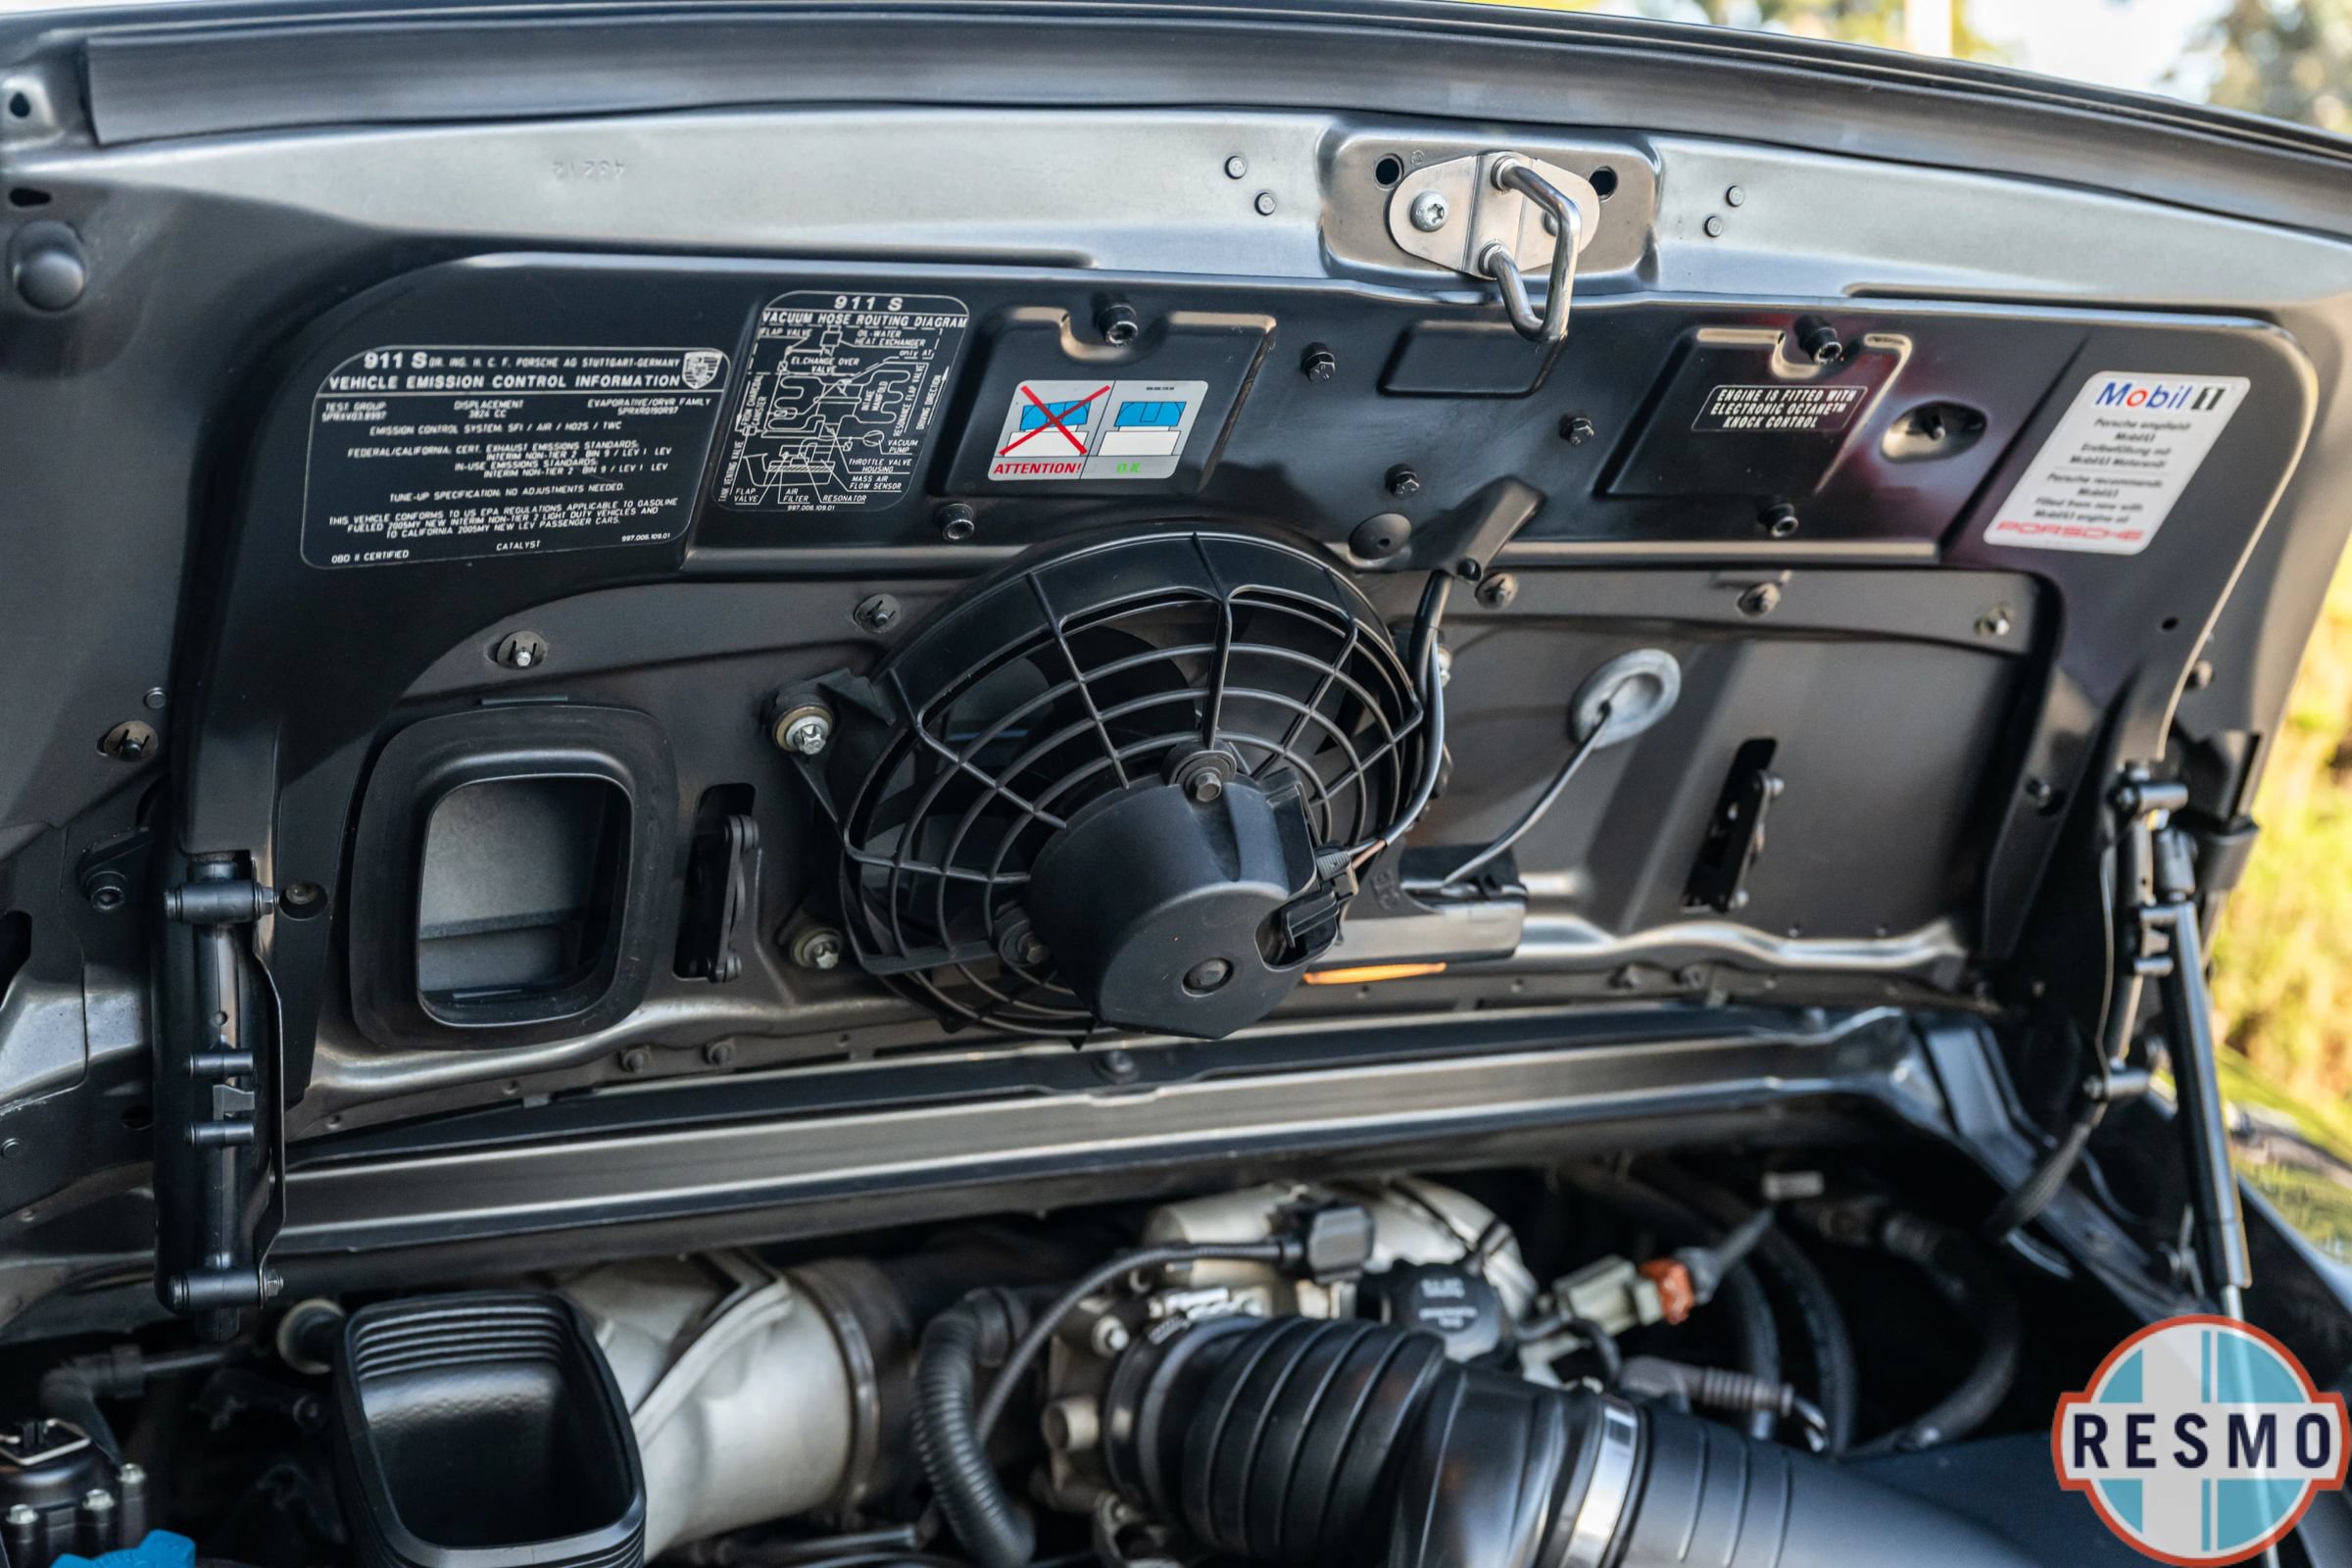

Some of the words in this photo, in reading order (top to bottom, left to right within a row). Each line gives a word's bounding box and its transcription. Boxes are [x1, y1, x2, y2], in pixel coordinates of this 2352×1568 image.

[834, 296, 876, 310] 911
[888, 297, 903, 311] S
[761, 312, 812, 323] VACUUM
[818, 314, 852, 324] HOSE
[857, 316, 908, 327] ROUTING
[914, 318, 968, 328] DIAGRAM
[857, 329, 902, 338] OIL-WATER
[364, 352, 403, 369] 911
[411, 352, 428, 368] S
[515, 358, 559, 368] PORSCHE
[564, 358, 576, 367] AG
[582, 358, 681, 368] STUTTGART-GERMANY
[328, 375, 399, 390] VEHICLE
[406, 375, 485, 389] EMISSION
[492, 374, 566, 388] CONTROL
[574, 374, 681, 387] INFORMATION
[893, 404, 911, 437] RESONANCE
[906, 385, 916, 401] FLAP
[912, 364, 925, 383] VALVE
[915, 407, 931, 429] DRIVING
[925, 374, 942, 405] DIRECTION
[1717, 389, 1763, 402] ENGINE
[1765, 390, 1779, 401] IS
[1782, 390, 1825, 402] FITTED
[1826, 390, 1857, 402] WITH
[2095, 382, 2193, 410] Mobil
[325, 402, 349, 412] TEST
[354, 401, 387, 411] GROUP
[454, 400, 523, 409] DISPLACEMENT
[1710, 403, 1784, 416] ELECTRONIC
[369, 425, 415, 436] EMISSION
[418, 424, 458, 434] CONTROL
[536, 422, 552, 431] AIR
[604, 421, 622, 430] TWC
[1723, 416, 1763, 428] KNOCK
[1765, 416, 1819, 428] CONTROL
[456, 445, 482, 455] CERT.
[486, 443, 527, 453] EXHAUST
[532, 442, 579, 452] EMISSIONS
[486, 452, 521, 461] INTERIM
[525, 451, 569, 460] NON-TIER
[622, 448, 640, 457] LEV
[731, 441, 744, 460] VALVE
[455, 462, 486, 471] IN-USE
[491, 461, 538, 469] EMISSIONS
[483, 469, 519, 478] INTERIM
[522, 467, 564, 476] NON-TIER
[601, 465, 607, 473] 9
[619, 464, 636, 472] LEV
[993, 463, 1083, 474] ATTENTION!
[390, 492, 430, 503] TUNE-UP
[505, 487, 517, 497] NO
[522, 485, 584, 496] ADJUSTMENTS
[589, 483, 624, 492] NEEDED.
[329, 516, 349, 526] THIS
[354, 514, 391, 524] VEHICLE
[395, 511, 444, 521] CONFORMS
[449, 510, 460, 518] TO
[480, 508, 499, 516] EPA
[504, 504, 563, 514] REGULATIONS
[566, 502, 618, 511] APPLICABLE
[637, 498, 678, 507] GASOLINE
[347, 523, 383, 533] FUELED
[450, 516, 484, 526] INTERIM
[488, 514, 528, 523] NON-TIER
[570, 510, 592, 518] DUTY
[597, 508, 636, 516] VEHICLES
[387, 530, 397, 539] TO
[402, 527, 454, 538] CALIFORNIA
[494, 522, 514, 531] NEW
[518, 521, 535, 530] LEV
[539, 518, 591, 528] PASSENGER
[596, 515, 620, 525] CARS.
[1996, 521, 2145, 542] PORSCHE
[496, 541, 541, 551] CATALYST
[331, 555, 350, 564] OBD
[364, 550, 410, 562] CERTIFIED
